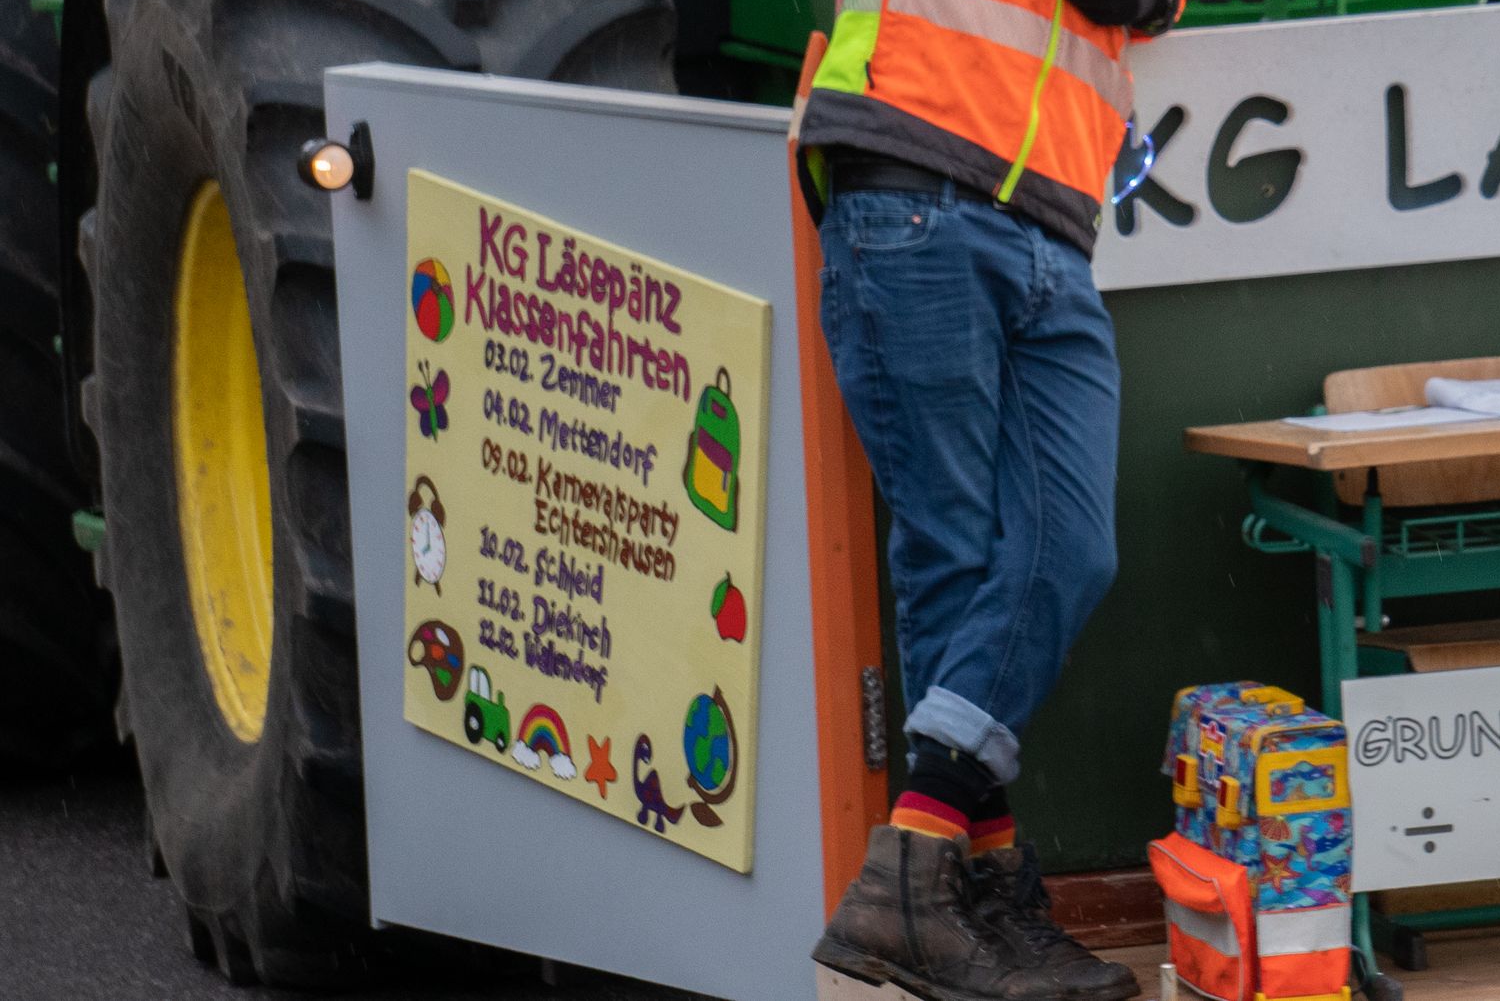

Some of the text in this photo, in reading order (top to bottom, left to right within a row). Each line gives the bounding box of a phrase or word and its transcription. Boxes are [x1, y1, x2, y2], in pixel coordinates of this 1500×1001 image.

[1113, 94, 1302, 236] KG
[479, 206, 682, 335] KG Läsepänz
[464, 263, 691, 404] Klassenfahrten
[484, 338, 622, 413] 03.02. Zemmer
[538, 408, 658, 486] Mettendorf
[481, 436, 679, 547] 09.02. Karnevalsparty
[533, 498, 676, 581] Echtershausen
[534, 546, 605, 605] Schleid
[532, 595, 613, 659] Diekirch
